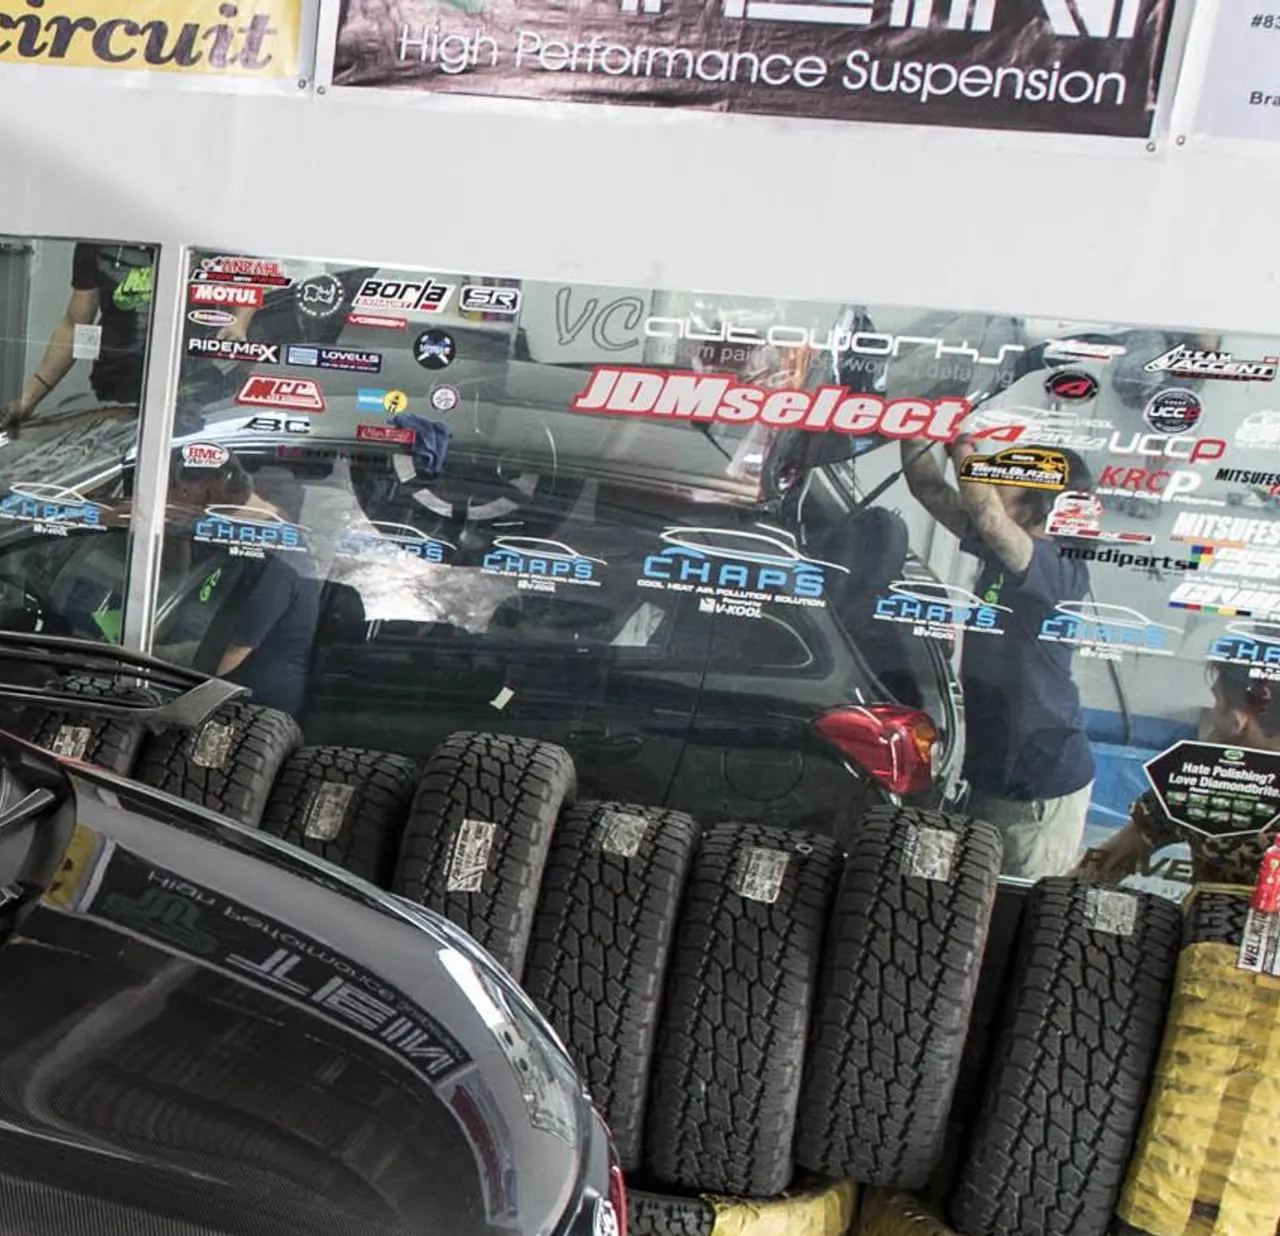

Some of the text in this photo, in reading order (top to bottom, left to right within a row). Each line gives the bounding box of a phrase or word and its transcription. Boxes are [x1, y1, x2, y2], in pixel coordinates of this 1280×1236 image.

[397, 23, 1127, 105] High Performance Suspension
[194, 285, 258, 304] MOTUL
[189, 338, 278, 362] RIDEMAX
[321, 350, 380, 363] LOVELLS
[1183, 350, 1233, 362] TEAM
[571, 366, 973, 442] JDMselect
[1109, 430, 1228, 464] UCCP
[196, 517, 299, 546] CHAPS
[483, 550, 593, 580] CHAPS
[1059, 546, 1187, 569] modiparts
[643, 547, 826, 598] CHAPS
[715, 603, 763, 619] V-KOOL
[875, 595, 999, 629] CHAPS
[1168, 772, 1198, 786] Love
[1182, 762, 1276, 785] Hate Polishing?
